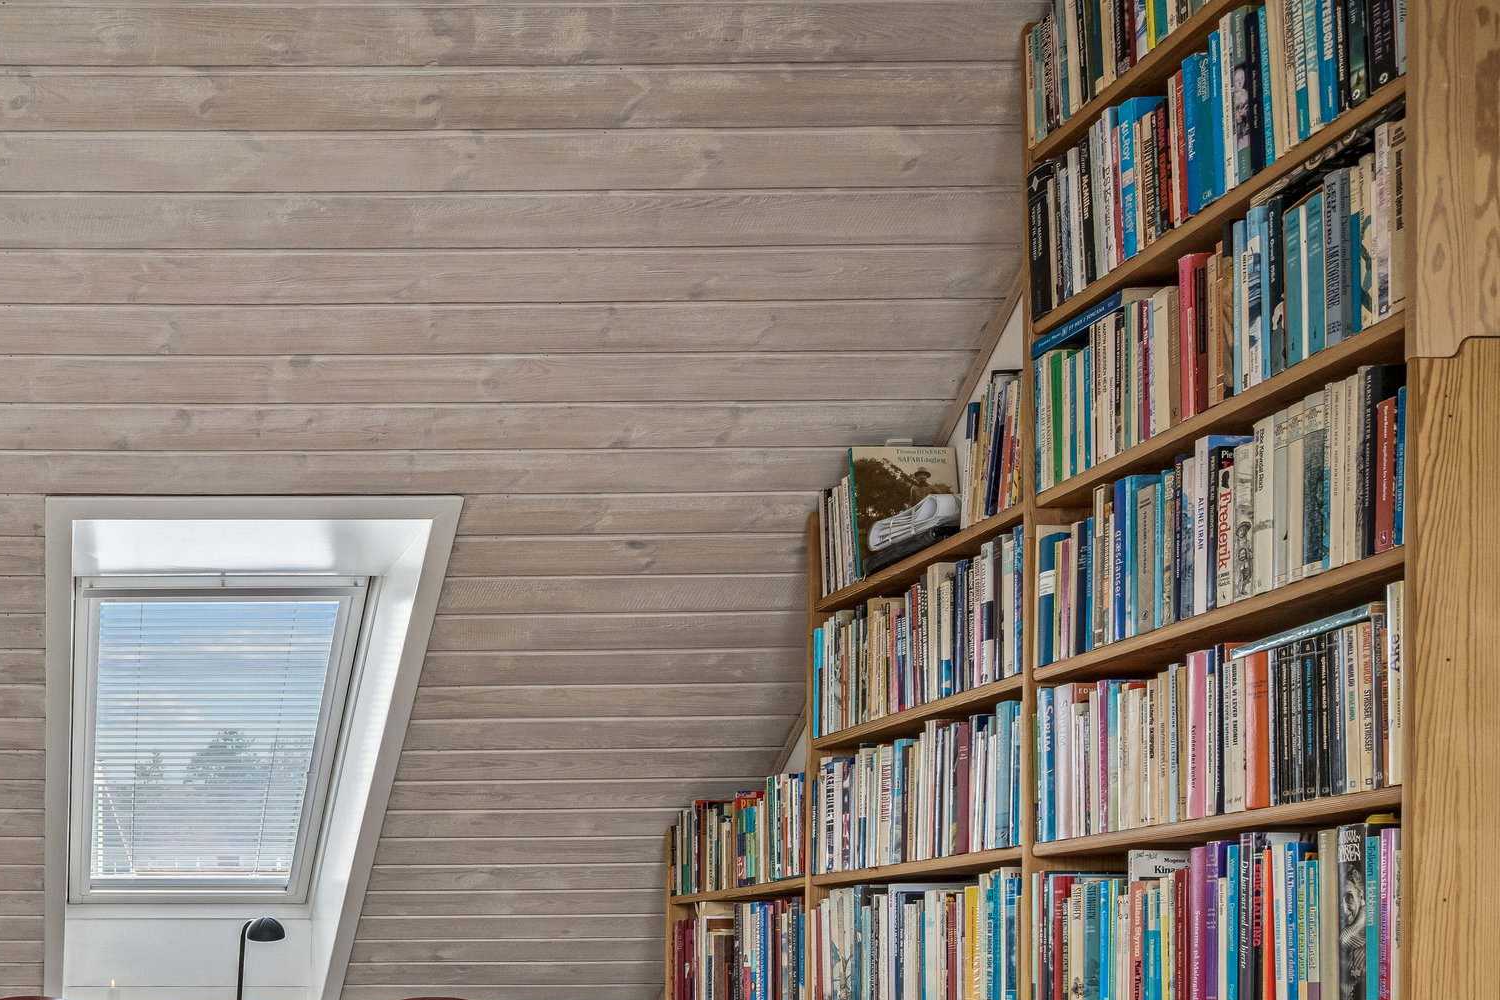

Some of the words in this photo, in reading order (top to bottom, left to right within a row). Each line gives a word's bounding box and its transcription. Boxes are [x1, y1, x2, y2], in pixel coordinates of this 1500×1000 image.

[1373, 2, 1382, 64] HERSKERE
[1120, 120, 1131, 160] KILROY
[1156, 108, 1166, 148] MORAVIA
[1187, 126, 1196, 161] Elskede
[1081, 175, 1090, 220] McMillan
[1124, 193, 1135, 234] KILROY
[1197, 497, 1205, 522] ALENE
[1219, 489, 1232, 570] Frederik
[1114, 530, 1123, 597] græsdanser
[1241, 860, 1249, 872] Du
[1253, 863, 1261, 893] ERIK
[1367, 844, 1376, 876] Tolkien
[1253, 896, 1261, 946] BALLING
[1367, 880, 1376, 926] Hobbitten
[1133, 927, 1141, 957] Styron
[1193, 910, 1201, 948] Swanerne
[1240, 942, 1248, 969] hjerte
